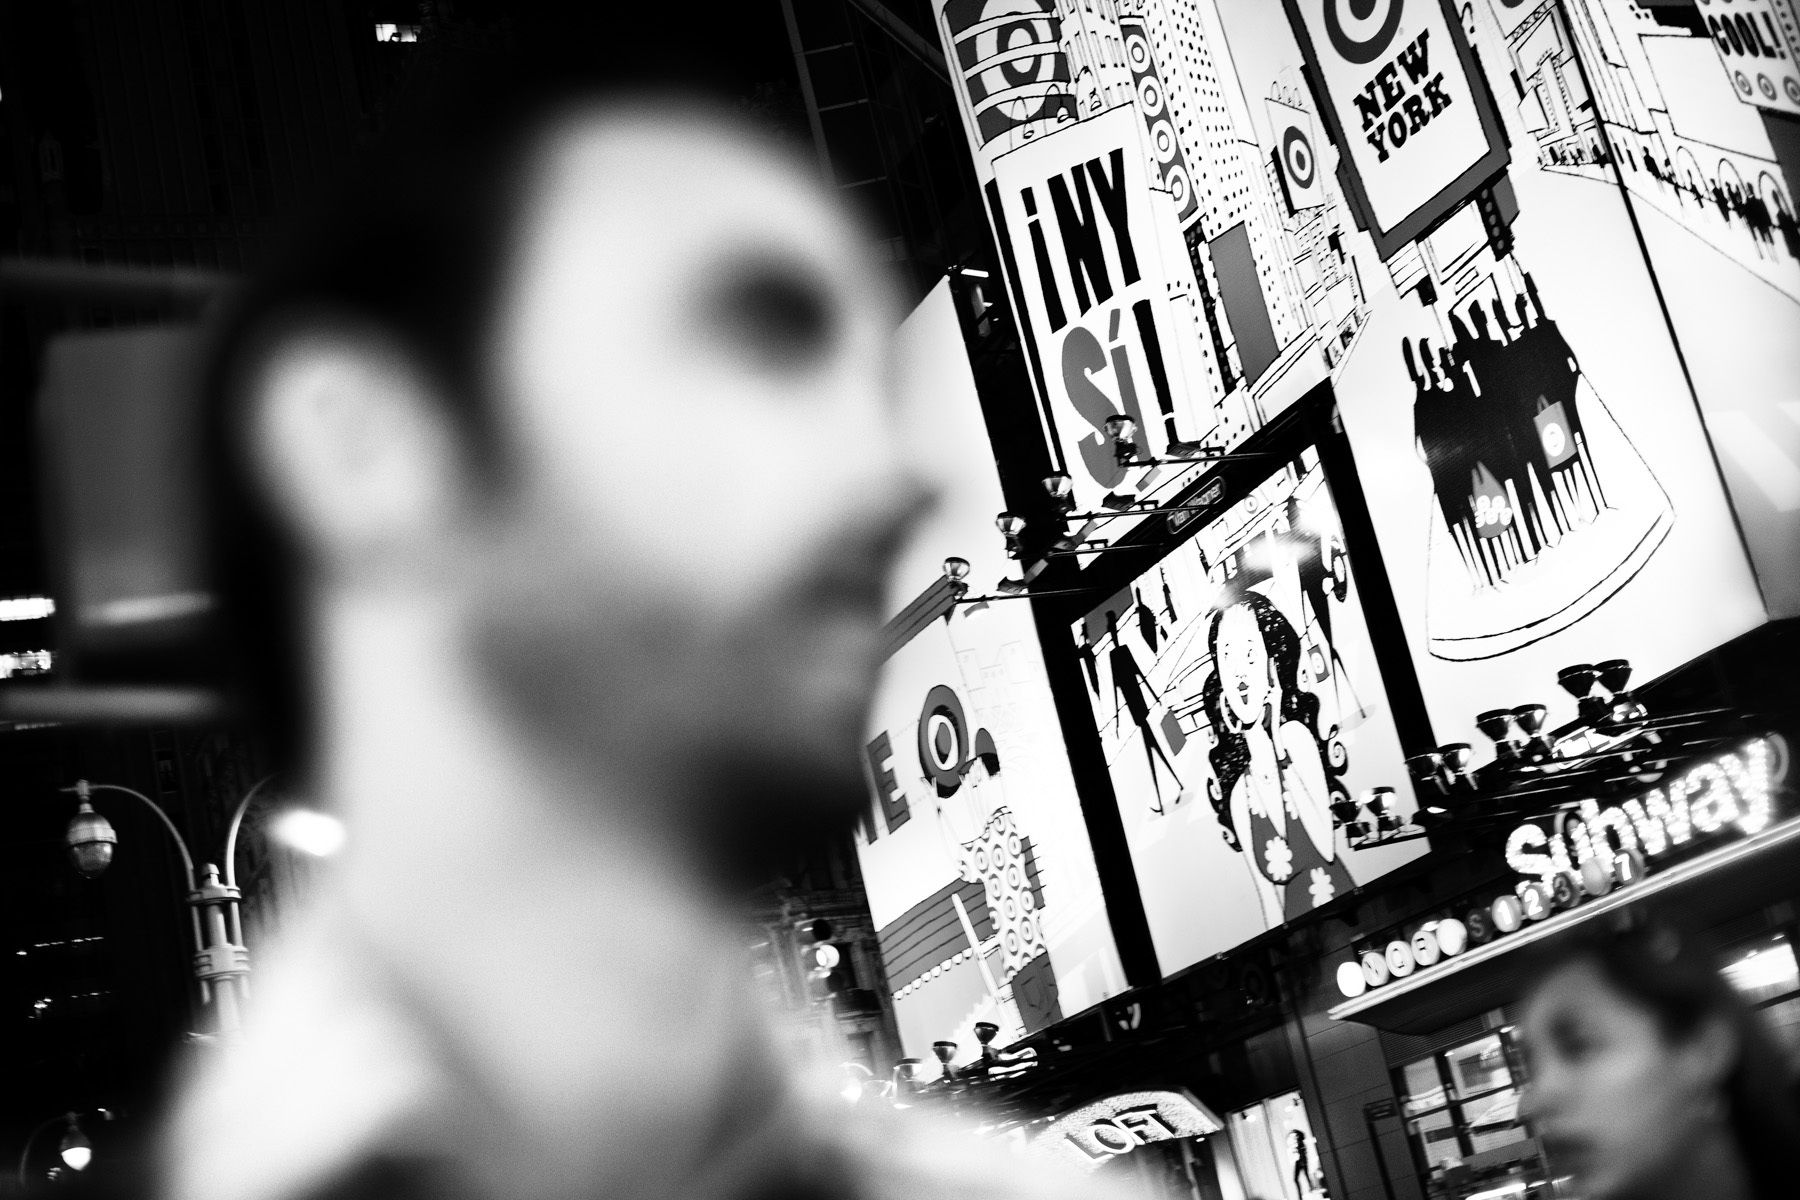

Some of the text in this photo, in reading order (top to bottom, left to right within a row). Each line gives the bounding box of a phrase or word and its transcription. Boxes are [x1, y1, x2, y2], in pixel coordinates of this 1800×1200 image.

[1708, 11, 1786, 60] COOL!
[1353, 27, 1430, 132] NEW
[1366, 71, 1452, 163] YORK
[1062, 1104, 1177, 1163] LOFT
